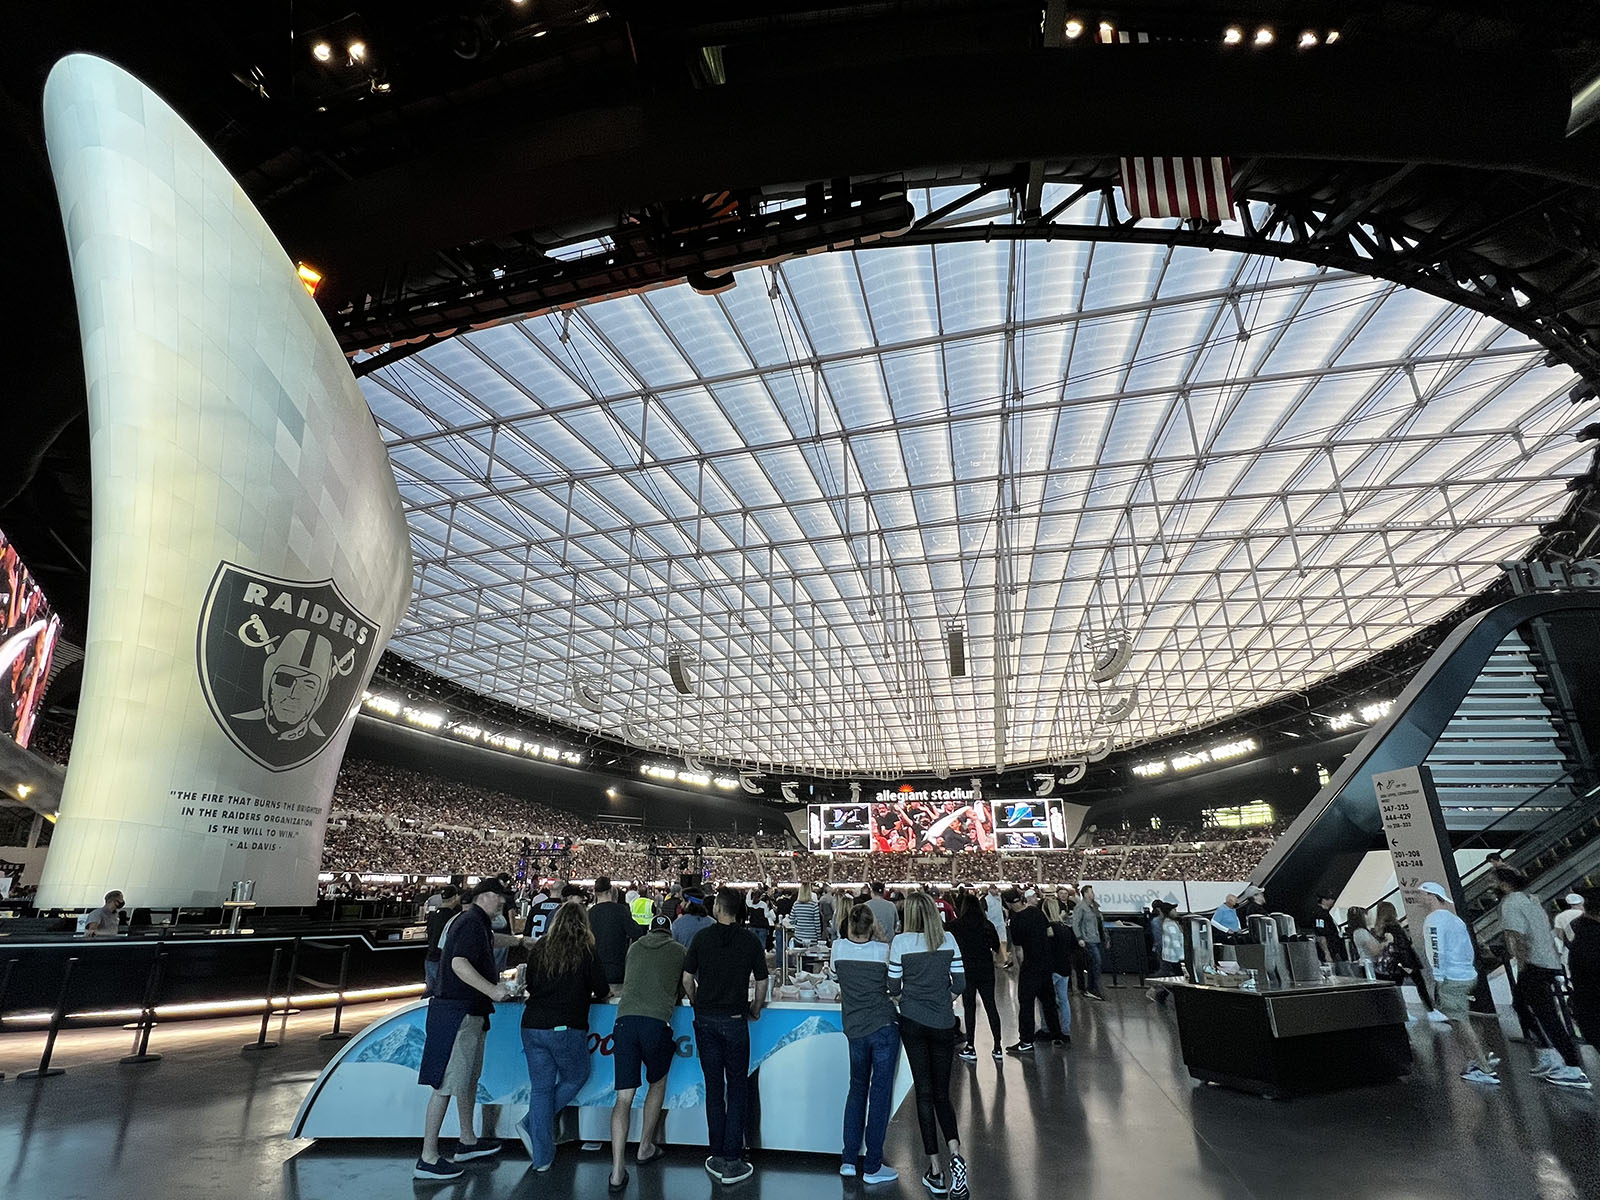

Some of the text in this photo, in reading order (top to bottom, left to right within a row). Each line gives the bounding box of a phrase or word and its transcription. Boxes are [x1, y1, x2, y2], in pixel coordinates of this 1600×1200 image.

[243, 582, 369, 645] RAIDERS
[201, 793, 225, 803] FIRE
[228, 795, 251, 806] THAT
[254, 799, 281, 809] BURNS
[283, 802, 295, 812] THE
[876, 789, 929, 802] allegiant
[181, 806, 313, 827] IN THE RAIDERS ORGANIZATION
[207, 824, 219, 833] IS
[222, 825, 239, 835] THE
[243, 827, 263, 836] WILL
[266, 828, 277, 837] TO
[236, 841, 277, 851] AL DAVIS
